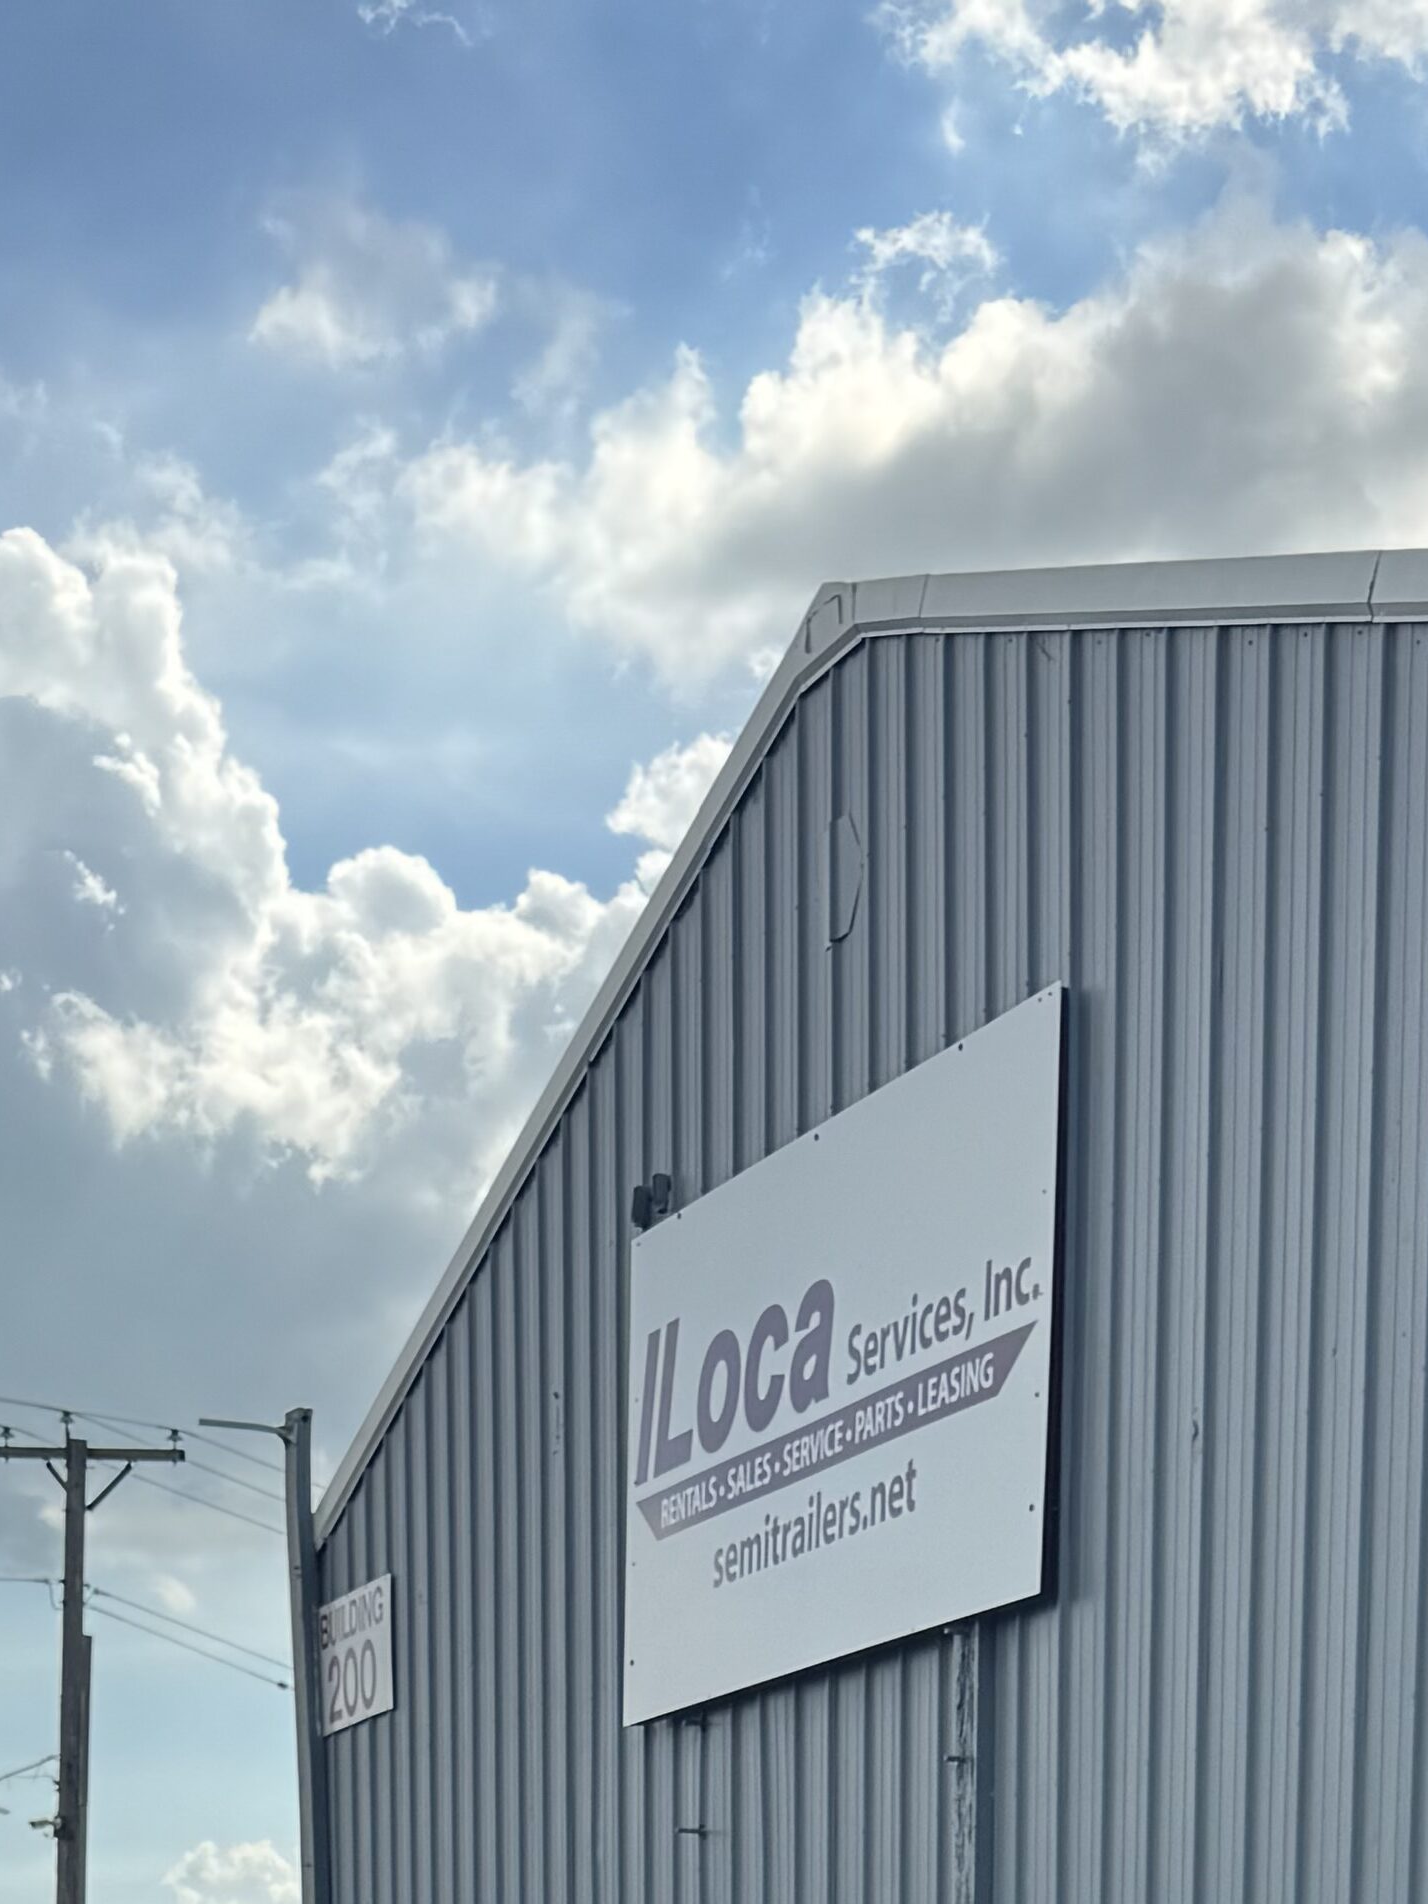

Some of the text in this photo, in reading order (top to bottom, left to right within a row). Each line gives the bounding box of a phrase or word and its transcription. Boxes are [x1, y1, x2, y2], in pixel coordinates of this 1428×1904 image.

[846, 1286, 975, 1386] Services,
[983, 1256, 1041, 1322] Inc.
[660, 1352, 994, 1530] RENTALS SALES SERVICE PARTS LEASING
[712, 1458, 918, 1589] semitrailers.net
[320, 1585, 384, 1650] BUILDING
[328, 1638, 377, 1724] 200
